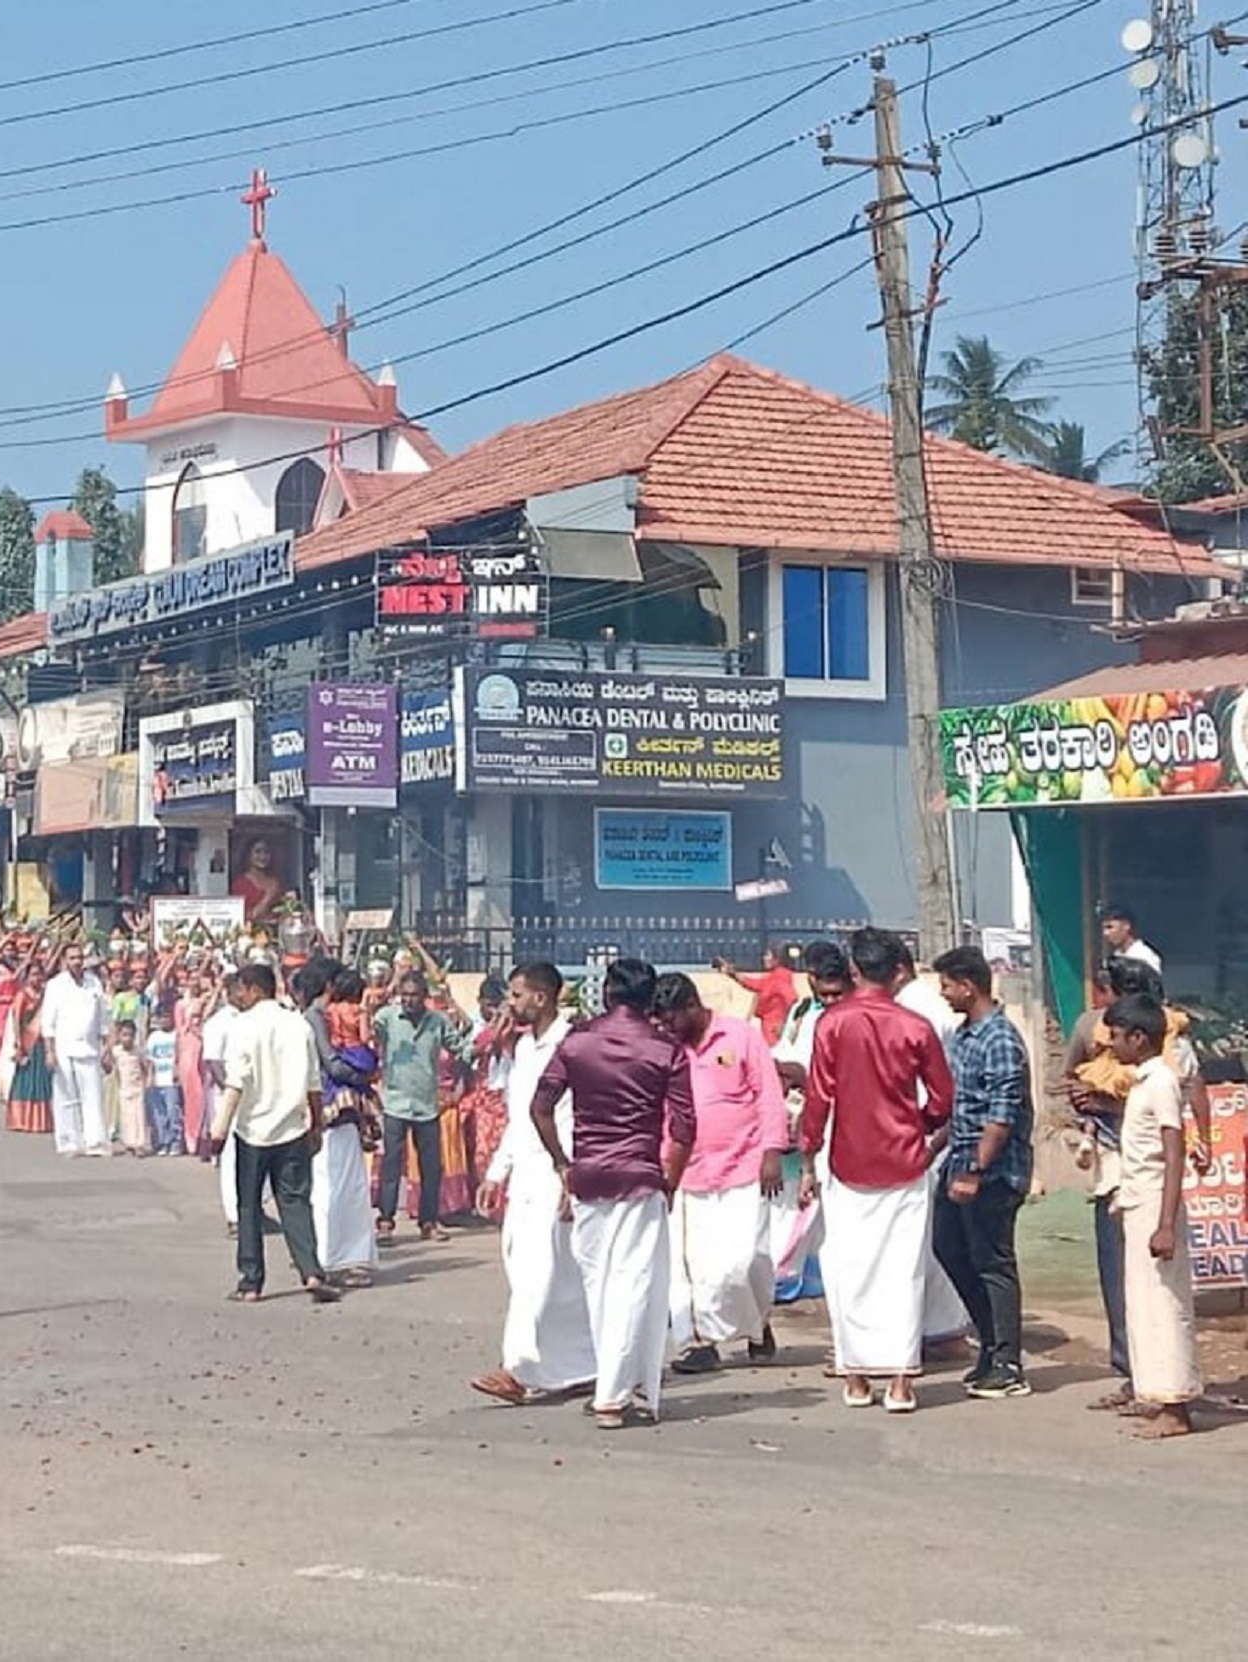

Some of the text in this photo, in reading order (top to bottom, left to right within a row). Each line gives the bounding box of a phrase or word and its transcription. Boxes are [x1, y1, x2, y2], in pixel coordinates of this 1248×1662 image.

[228, 542, 290, 590] COMPLEX
[382, 585, 538, 613] NEST INN
[323, 721, 383, 737] e-Lobby
[527, 706, 781, 732] PANACEA DENTAL & POLYCLINIC
[1018, 714, 1116, 771] ತರಕಾರಿ
[1128, 710, 1220, 766] ಅಂಗಡಿ
[331, 755, 376, 770] ATM
[602, 760, 691, 777] KEERTHAN
[696, 763, 781, 781] MEDICALS
[1188, 1219, 1248, 1250] EAL
[1192, 1253, 1247, 1278] EAD
